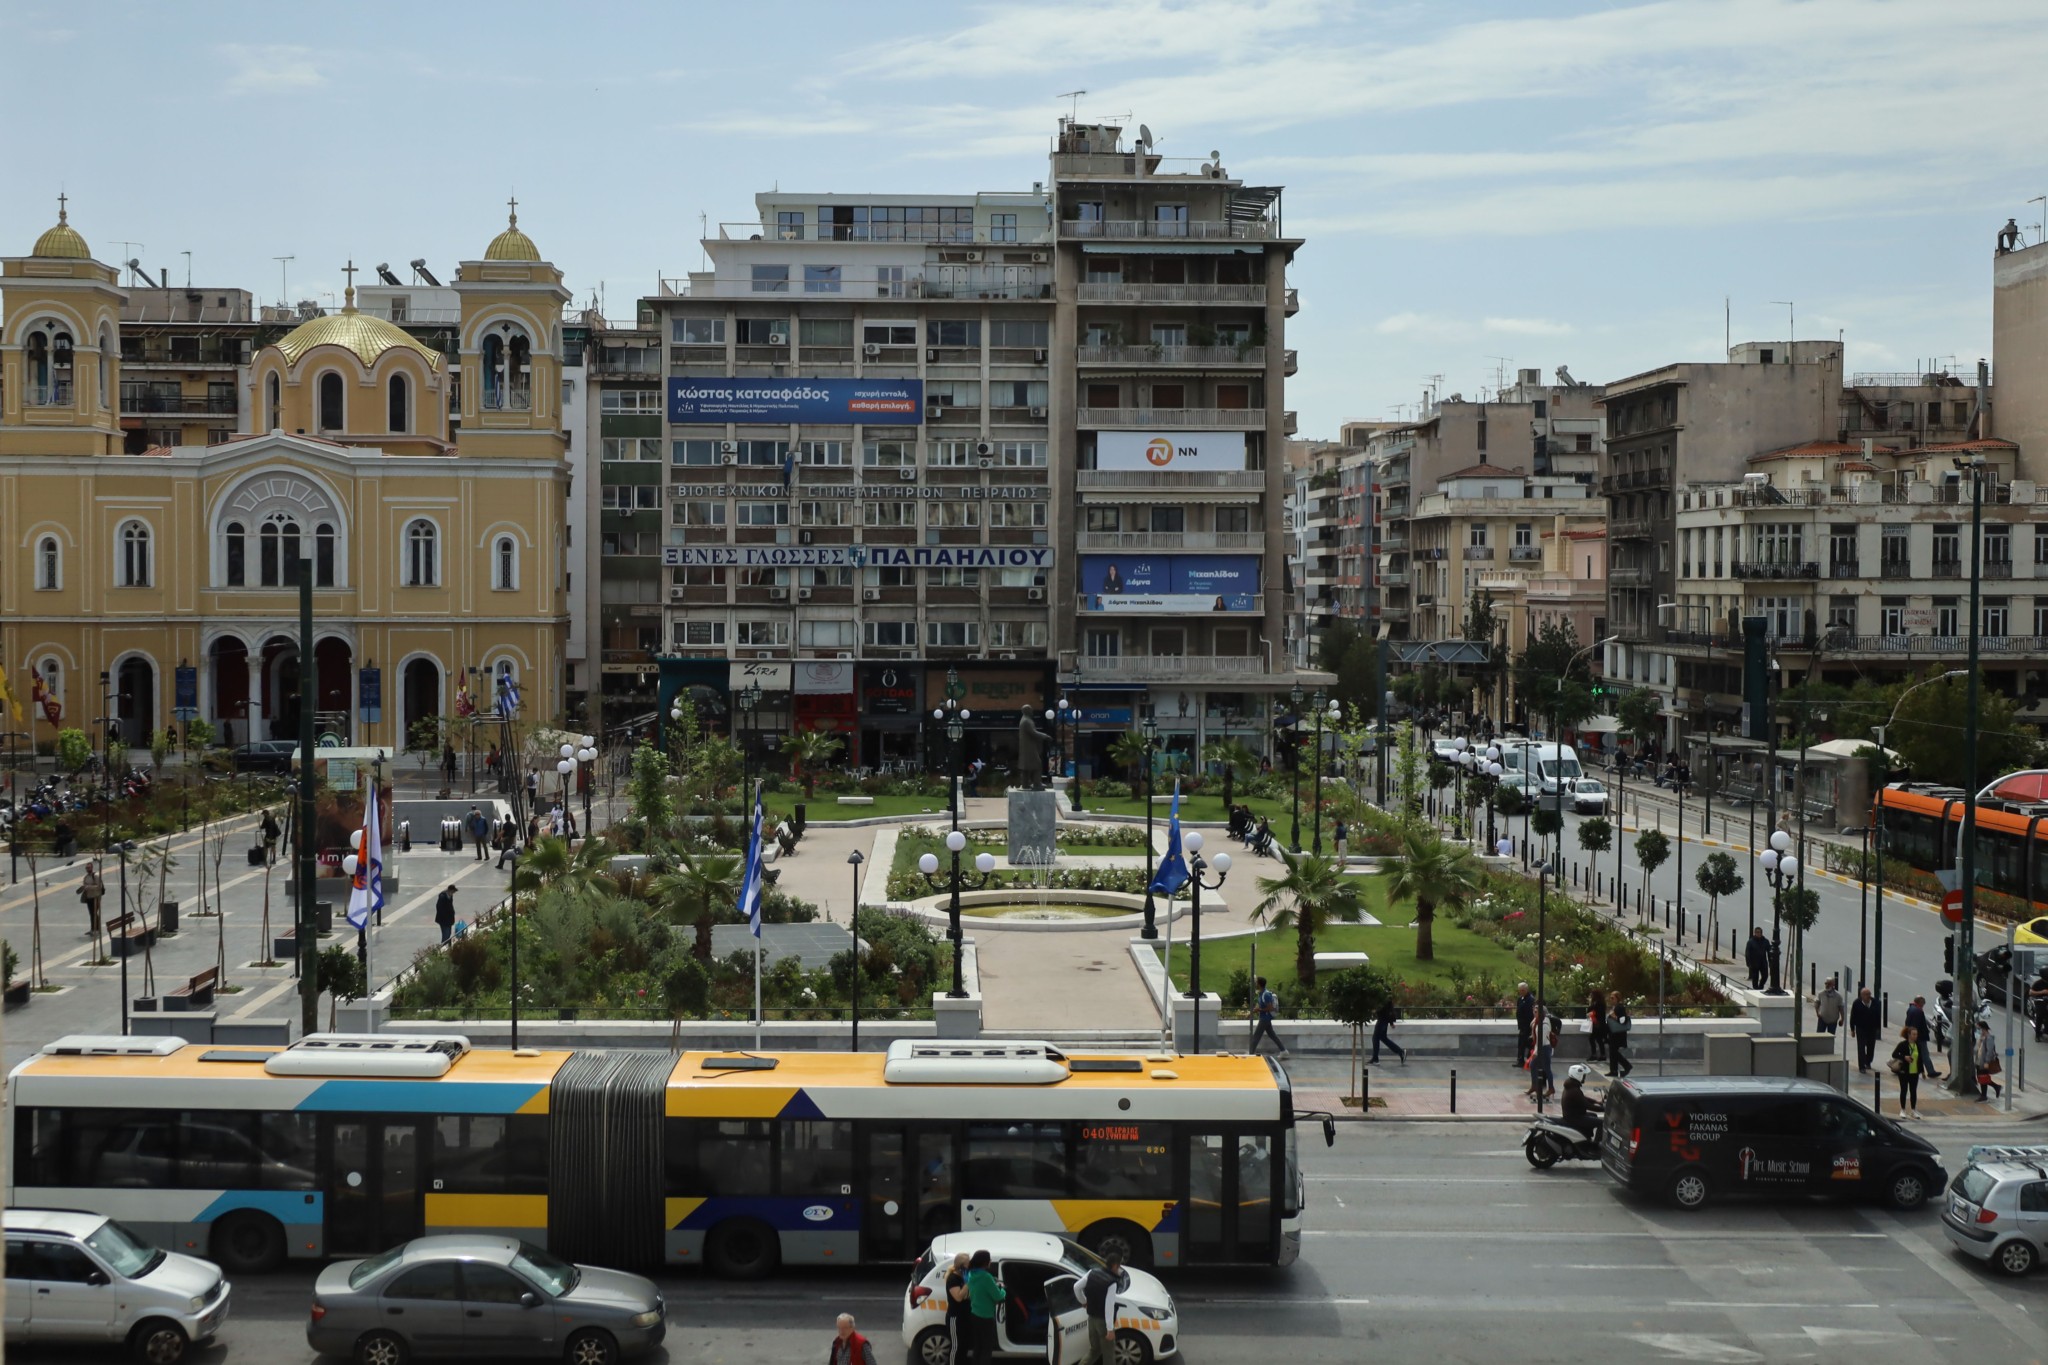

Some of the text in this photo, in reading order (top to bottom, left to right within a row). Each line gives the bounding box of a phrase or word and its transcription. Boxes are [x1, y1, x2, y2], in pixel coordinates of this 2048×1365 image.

[678, 386, 829, 402] κώστας κατσαφάδος
[855, 390, 909, 399] ισχυρή εντολή.
[852, 402, 912, 410] καθαρή επιλογή.
[1178, 447, 1198, 456] NN
[678, 486, 1038, 498] ΒΙΟΤΕΧΝΙΚΟΝ ΕΠΙΜΕΛΗΤΗΡΙΟΝ ΠΕΙΡΑΙΩΣ
[666, 549, 738, 565] ΞΕΝΕΣ
[746, 549, 844, 565] ΓΛΩΣΣΕΣ
[871, 549, 1048, 566] ΠΑΠΑΗΛΙΟΥ
[1188, 570, 1239, 578] Μιχαηλίδου
[1126, 578, 1151, 587] Δόμνα
[1689, 1113, 1728, 1122] YIORGOS
[1689, 1122, 1729, 1132] FAKANAS
[1082, 1127, 1105, 1139] 040
[1689, 1132, 1721, 1141] GROUP
[1767, 1160, 1787, 1173] Music
[1789, 1160, 1810, 1174] School
